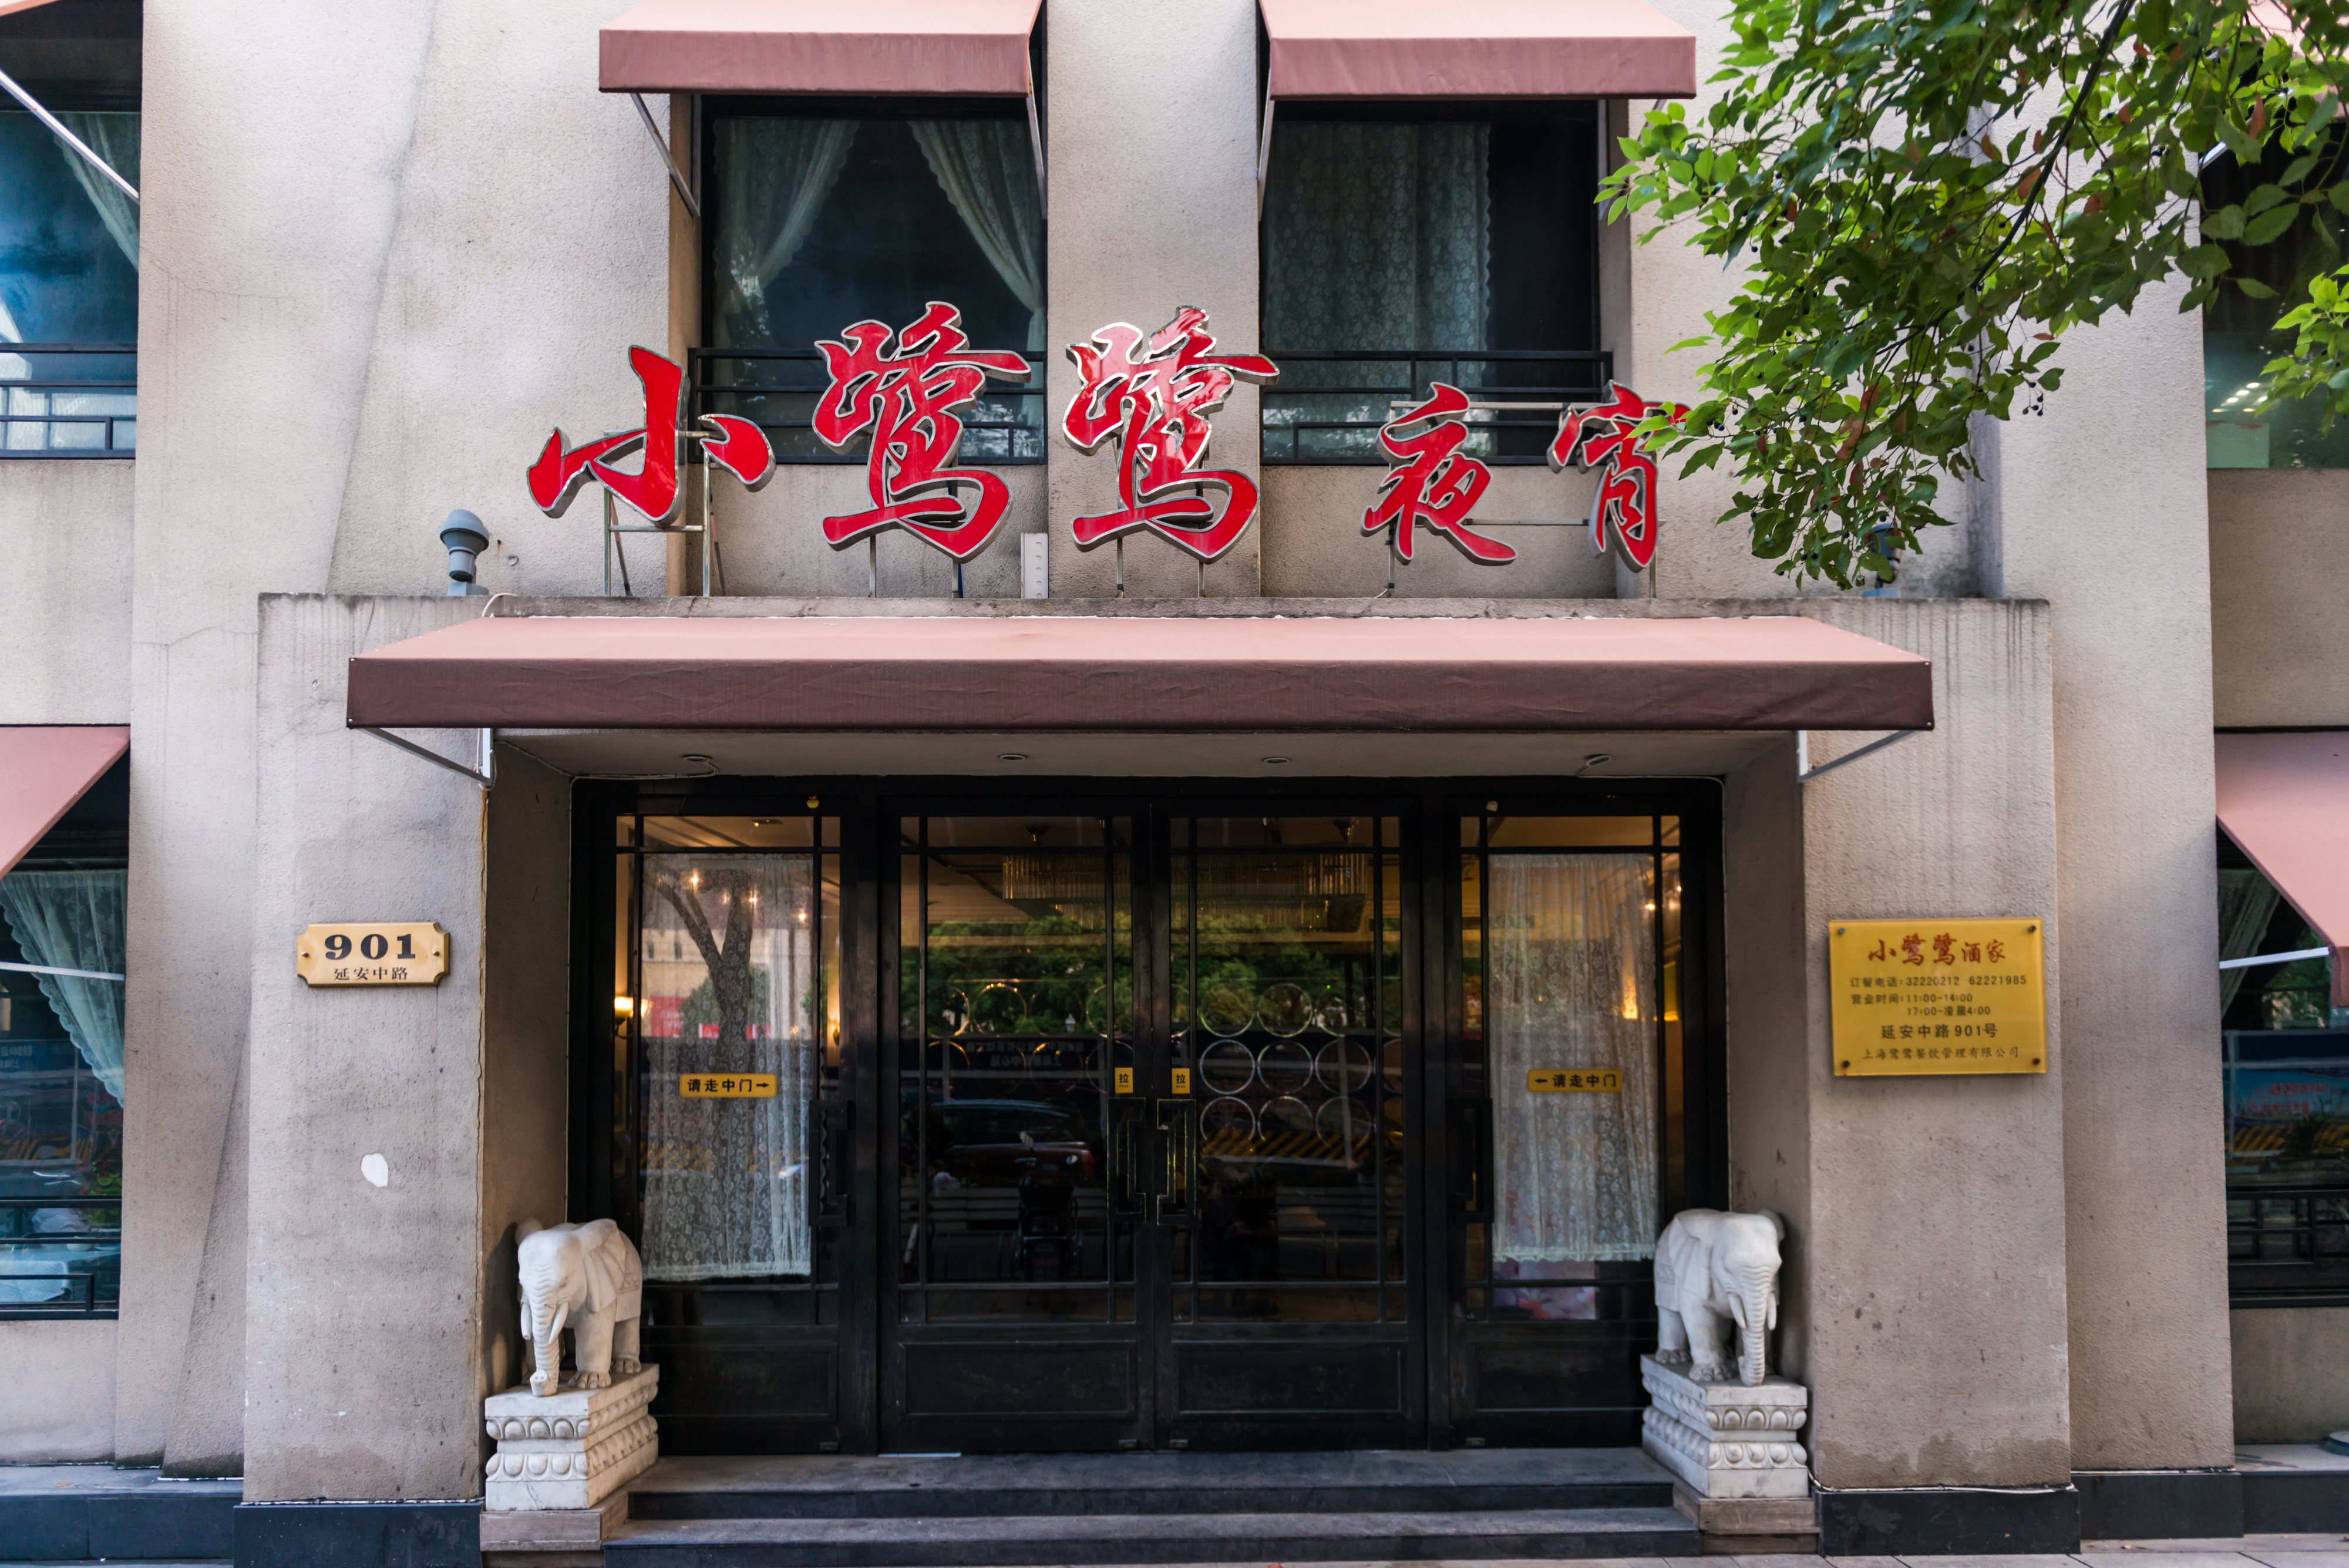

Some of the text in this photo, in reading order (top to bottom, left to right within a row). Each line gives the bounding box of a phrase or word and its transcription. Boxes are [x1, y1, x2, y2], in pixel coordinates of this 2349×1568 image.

[324, 934, 416, 960] 901
[334, 967, 408, 981] 延安中路
[1969, 975, 2027, 985] 62221985
[686, 1078, 753, 1093] 请走中门
[1119, 1073, 1129, 1084] 拉
[1176, 1074, 1186, 1084] 拉
[1552, 1074, 1617, 1088] 请走中门
